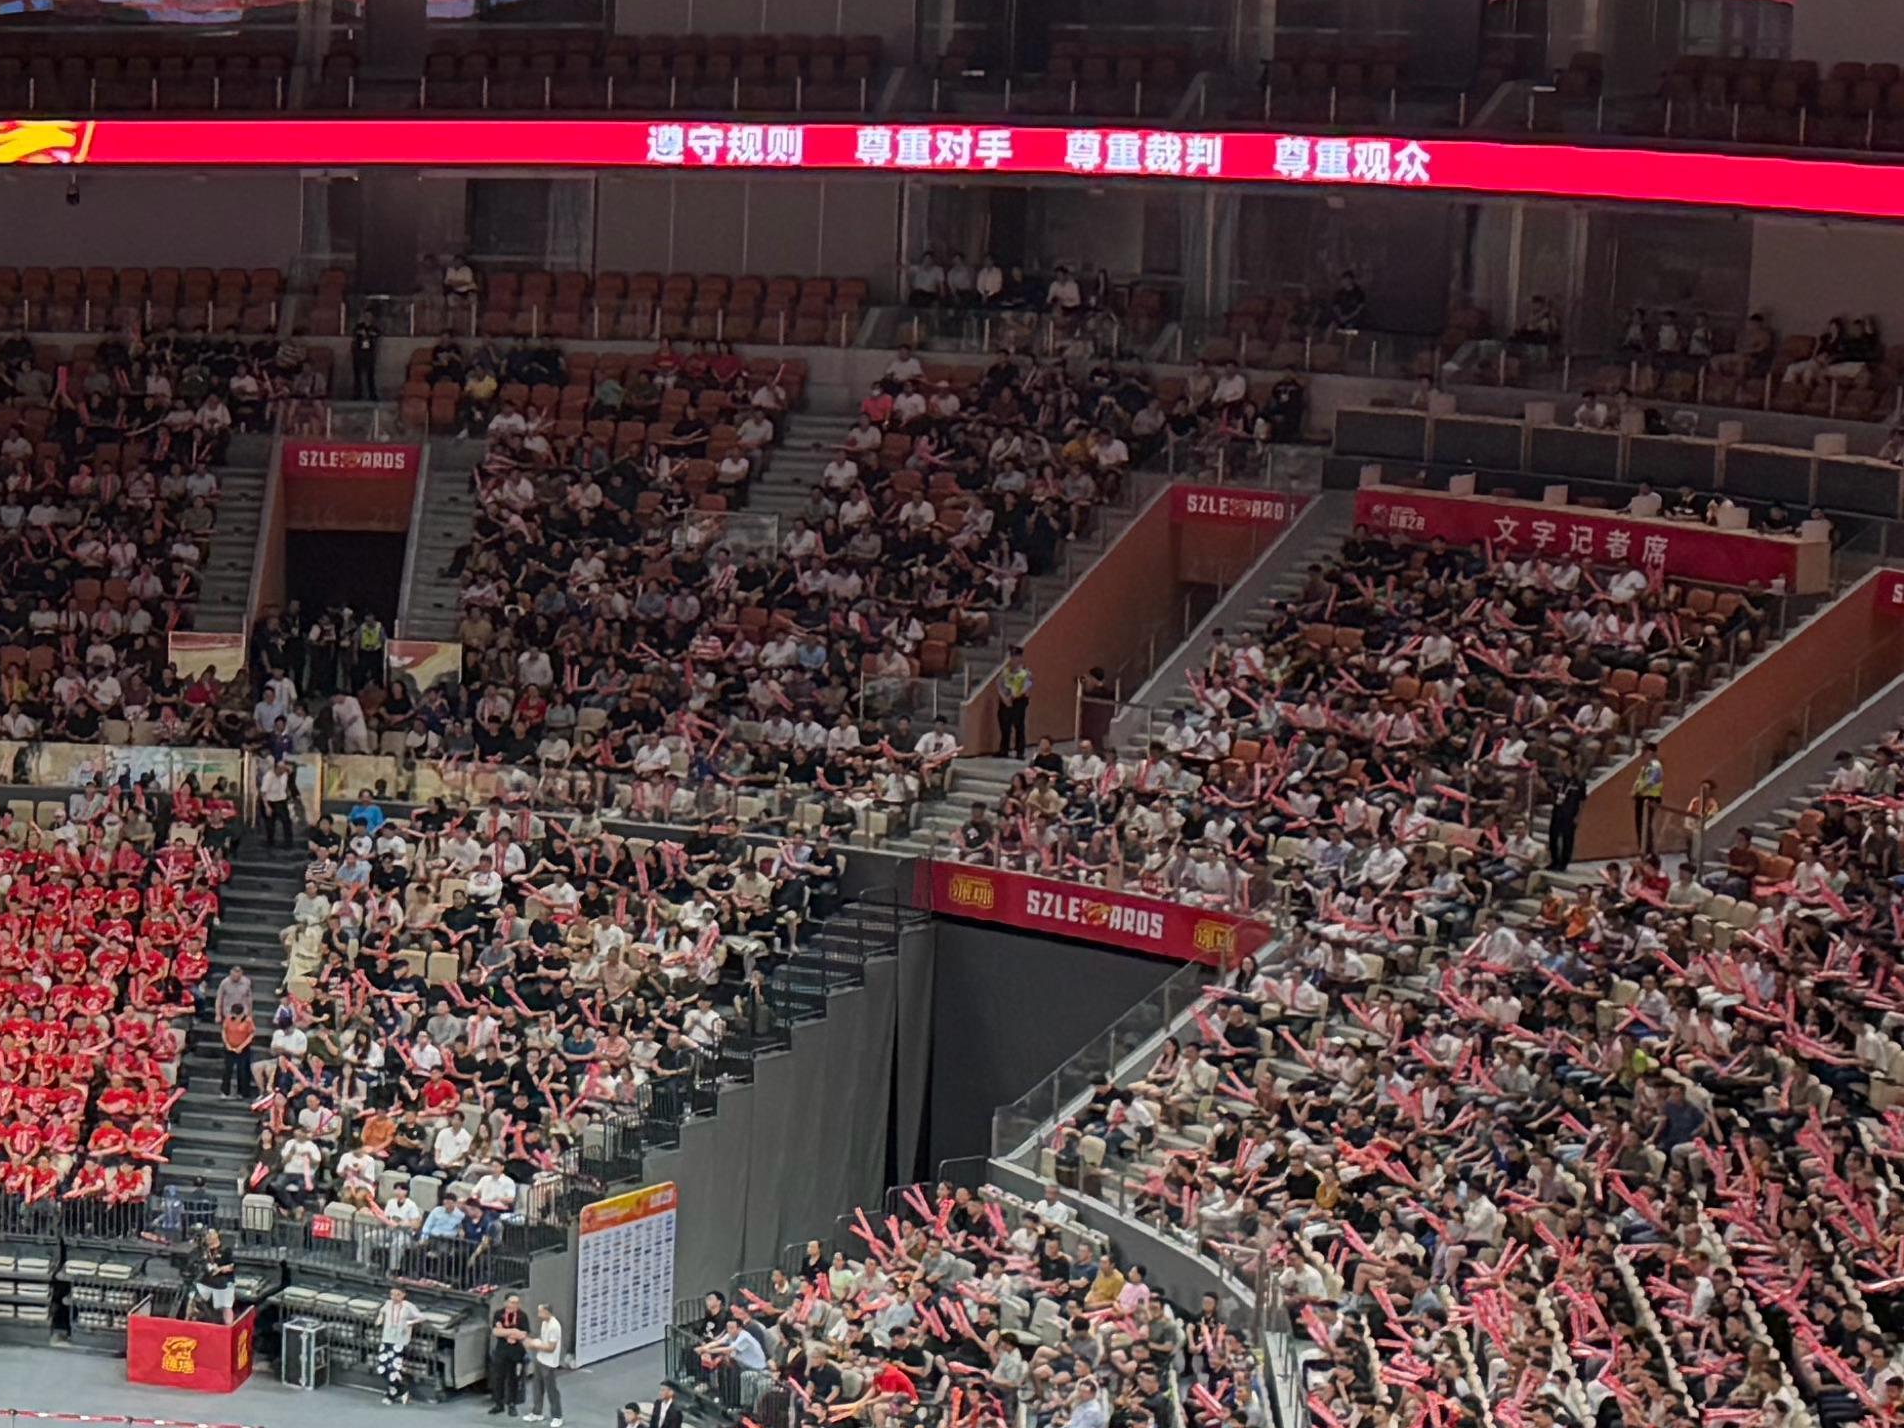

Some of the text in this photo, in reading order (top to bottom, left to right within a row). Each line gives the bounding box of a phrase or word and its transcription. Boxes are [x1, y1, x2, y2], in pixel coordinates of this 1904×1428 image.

[648, 125, 1430, 182] 遵守规则 尊重对手 尊重裁判 尊重观众
[298, 450, 406, 470] SZLEARDS
[1492, 513, 1669, 566] 文字记者席
[1026, 888, 1165, 942] SZLEARDS
